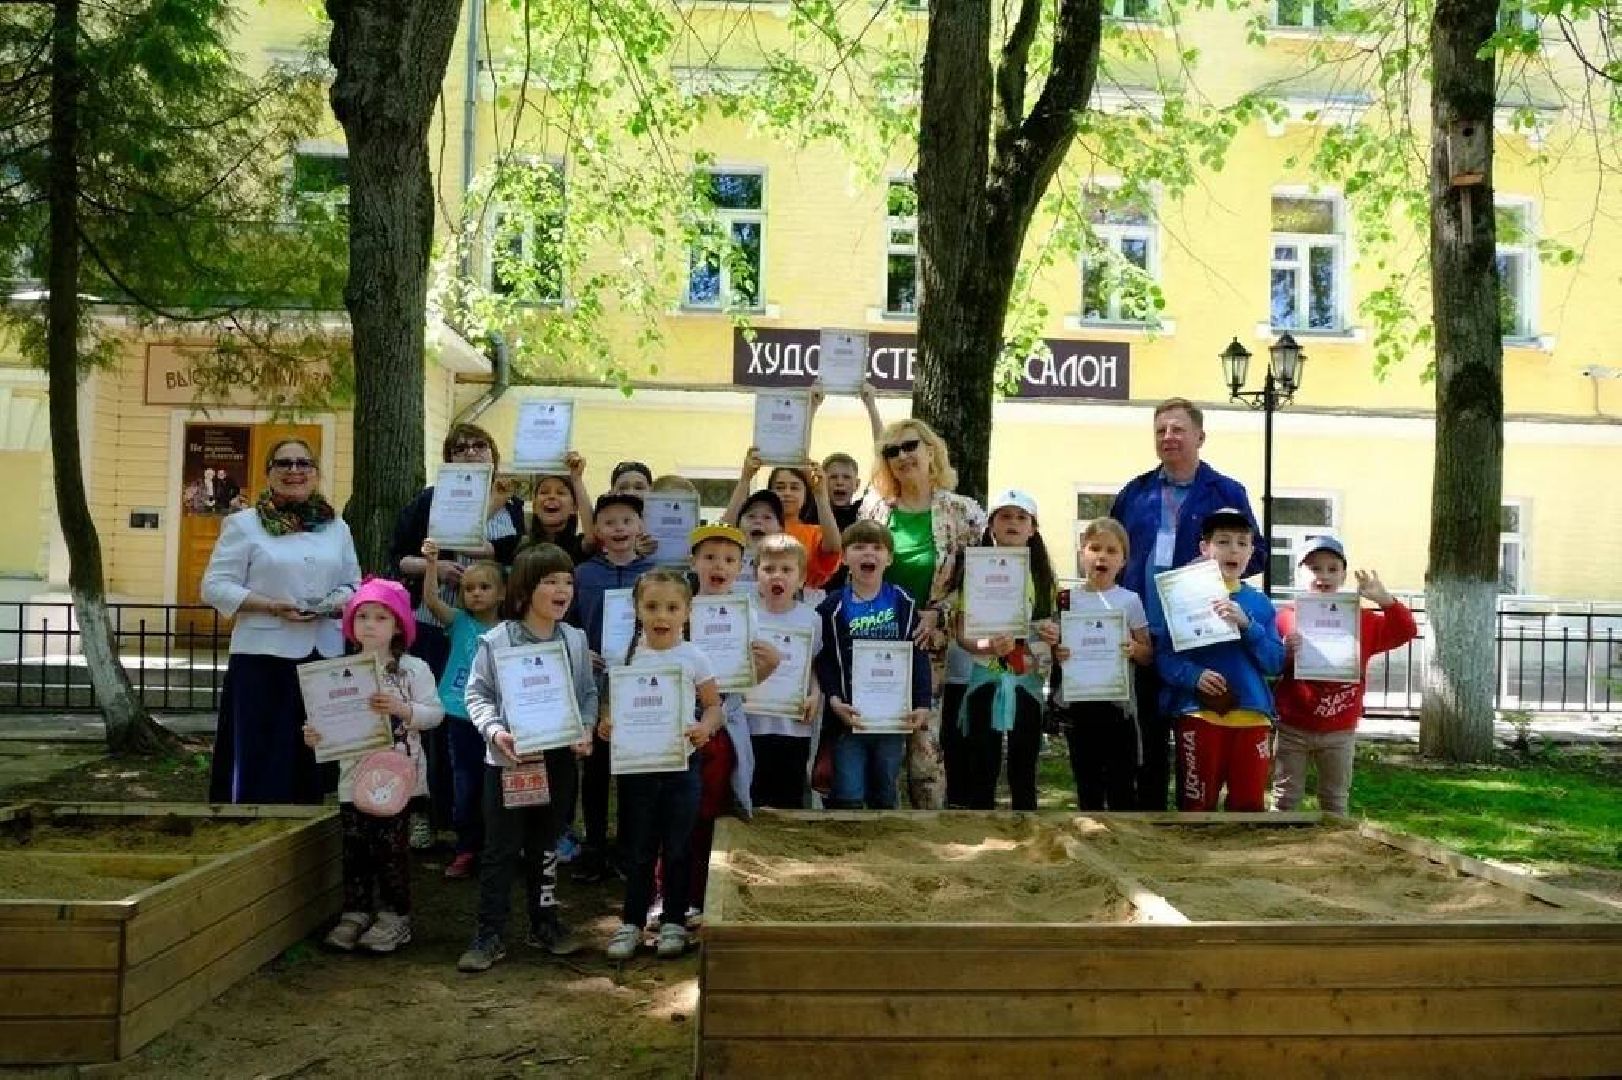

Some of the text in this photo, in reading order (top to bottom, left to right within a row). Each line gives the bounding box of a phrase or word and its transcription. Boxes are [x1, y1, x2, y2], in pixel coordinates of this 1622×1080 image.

[1024, 353, 1118, 388] САЛОН
[849, 607, 896, 636] SPACE
[540, 850, 561, 908] PLAY
